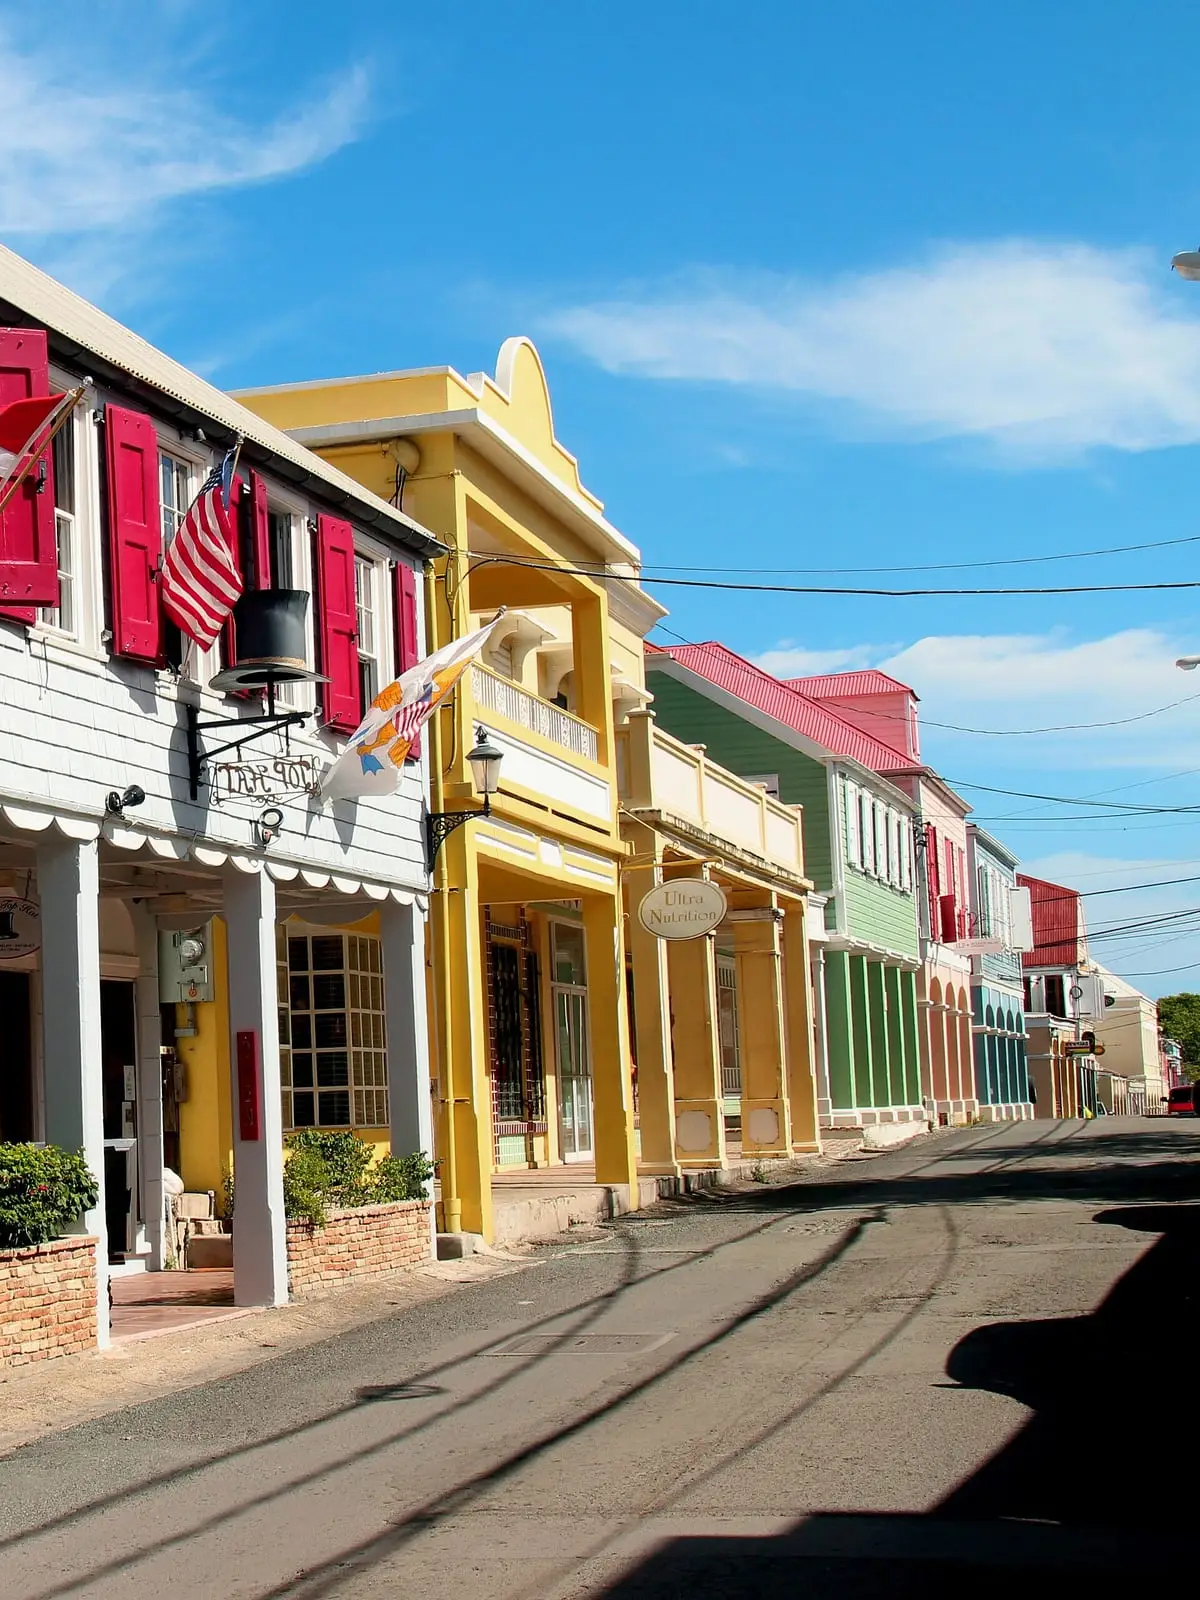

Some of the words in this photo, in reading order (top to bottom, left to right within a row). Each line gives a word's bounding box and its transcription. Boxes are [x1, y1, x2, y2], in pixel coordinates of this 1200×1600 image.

[664, 891, 705, 906] Ultra
[0, 899, 18, 911] Top
[19, 901, 40, 919] Hat
[649, 909, 717, 925] Nutrition
